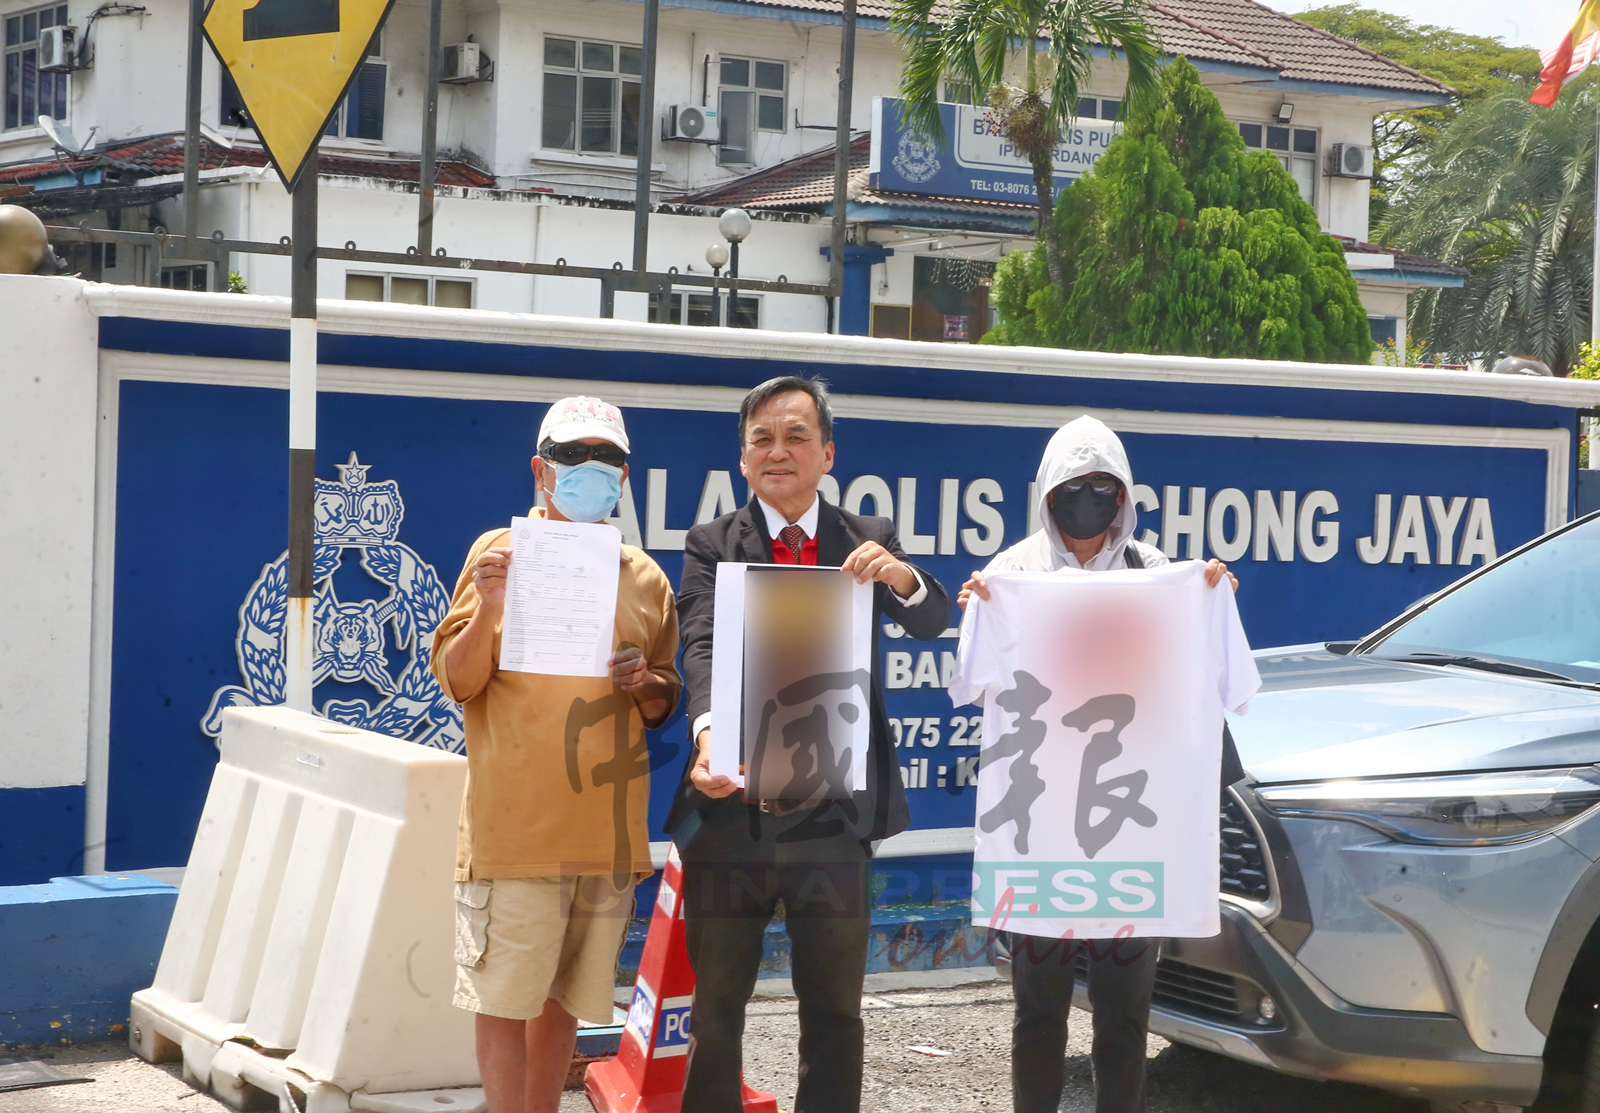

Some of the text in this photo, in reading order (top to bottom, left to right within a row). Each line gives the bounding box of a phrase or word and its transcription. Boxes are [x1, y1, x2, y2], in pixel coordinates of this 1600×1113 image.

[970, 180, 991, 190] TEL:
[993, 182, 1030, 196] 03-8076
[1356, 493, 1497, 565] JAYA
